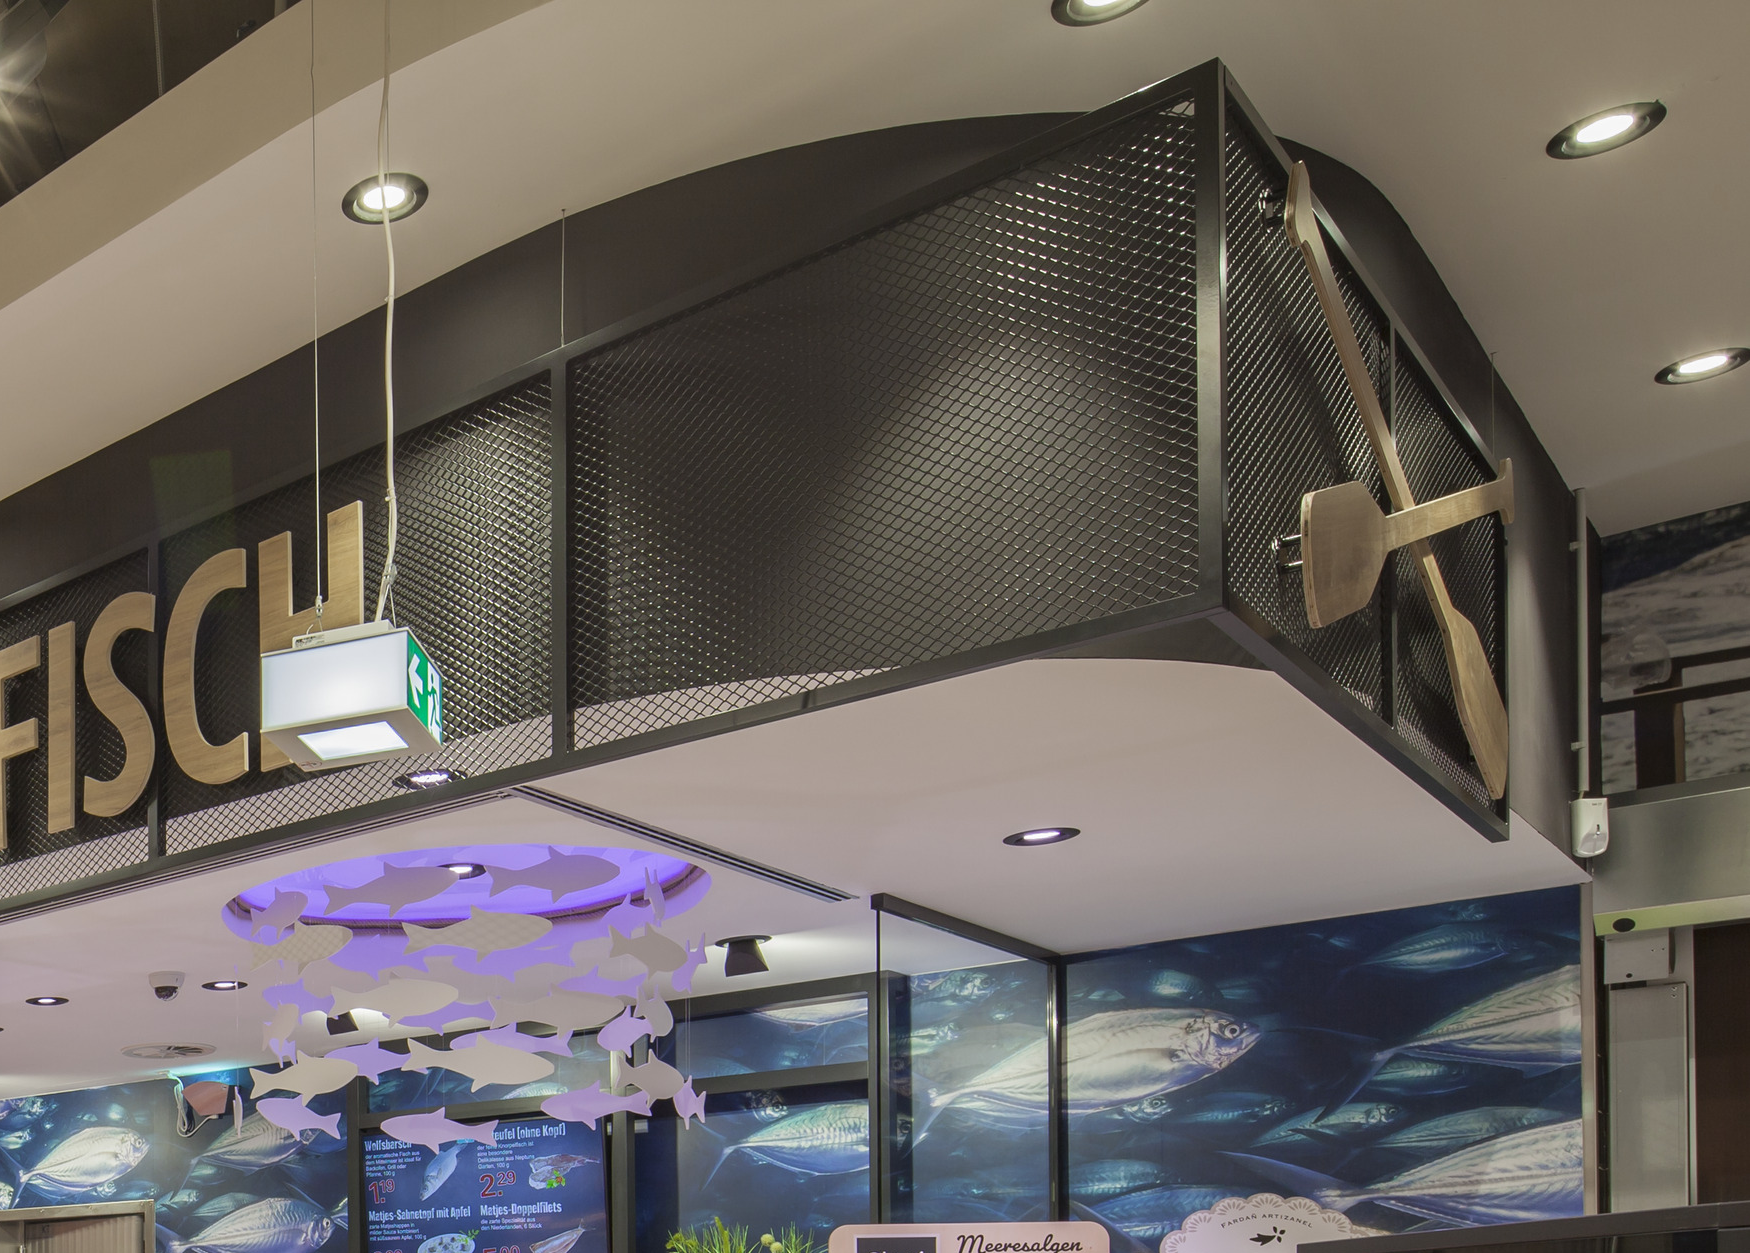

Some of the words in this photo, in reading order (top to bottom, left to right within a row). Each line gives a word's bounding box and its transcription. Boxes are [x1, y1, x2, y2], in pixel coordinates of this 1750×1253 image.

[517, 1126, 541, 1140] (ohne
[542, 1123, 566, 1138] Kopf)
[368, 1208, 435, 1223] Matjes-Sahnetopf
[436, 1206, 450, 1218] mit
[450, 1205, 471, 1220] Apfel
[480, 1202, 563, 1217] Matjes-Doppelfilets
[1220, 1213, 1258, 1229] FARDAÑ
[1261, 1213, 1313, 1229] ARTIZANEL
